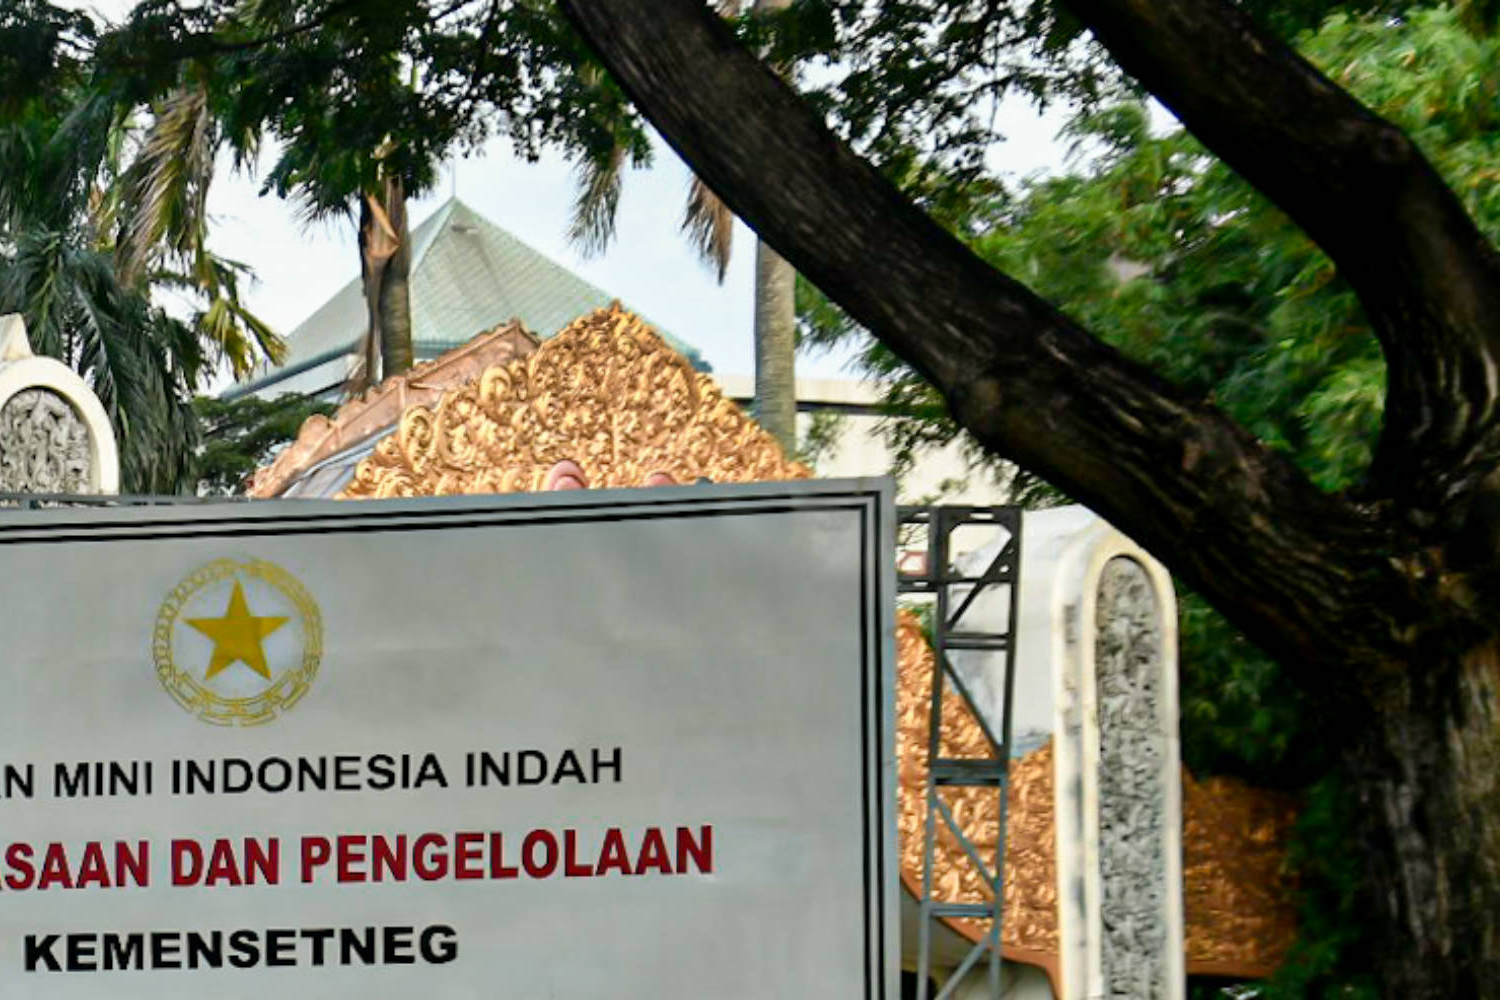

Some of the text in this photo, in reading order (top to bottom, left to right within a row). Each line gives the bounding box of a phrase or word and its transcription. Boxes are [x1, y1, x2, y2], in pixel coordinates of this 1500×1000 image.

[54, 761, 153, 798] MINI
[172, 753, 449, 795] INDONESIA
[466, 747, 622, 787] INDAH
[171, 837, 279, 887] DAN
[300, 824, 712, 884] PENGELOLAAN
[24, 924, 459, 971] KEMENSETNEG
